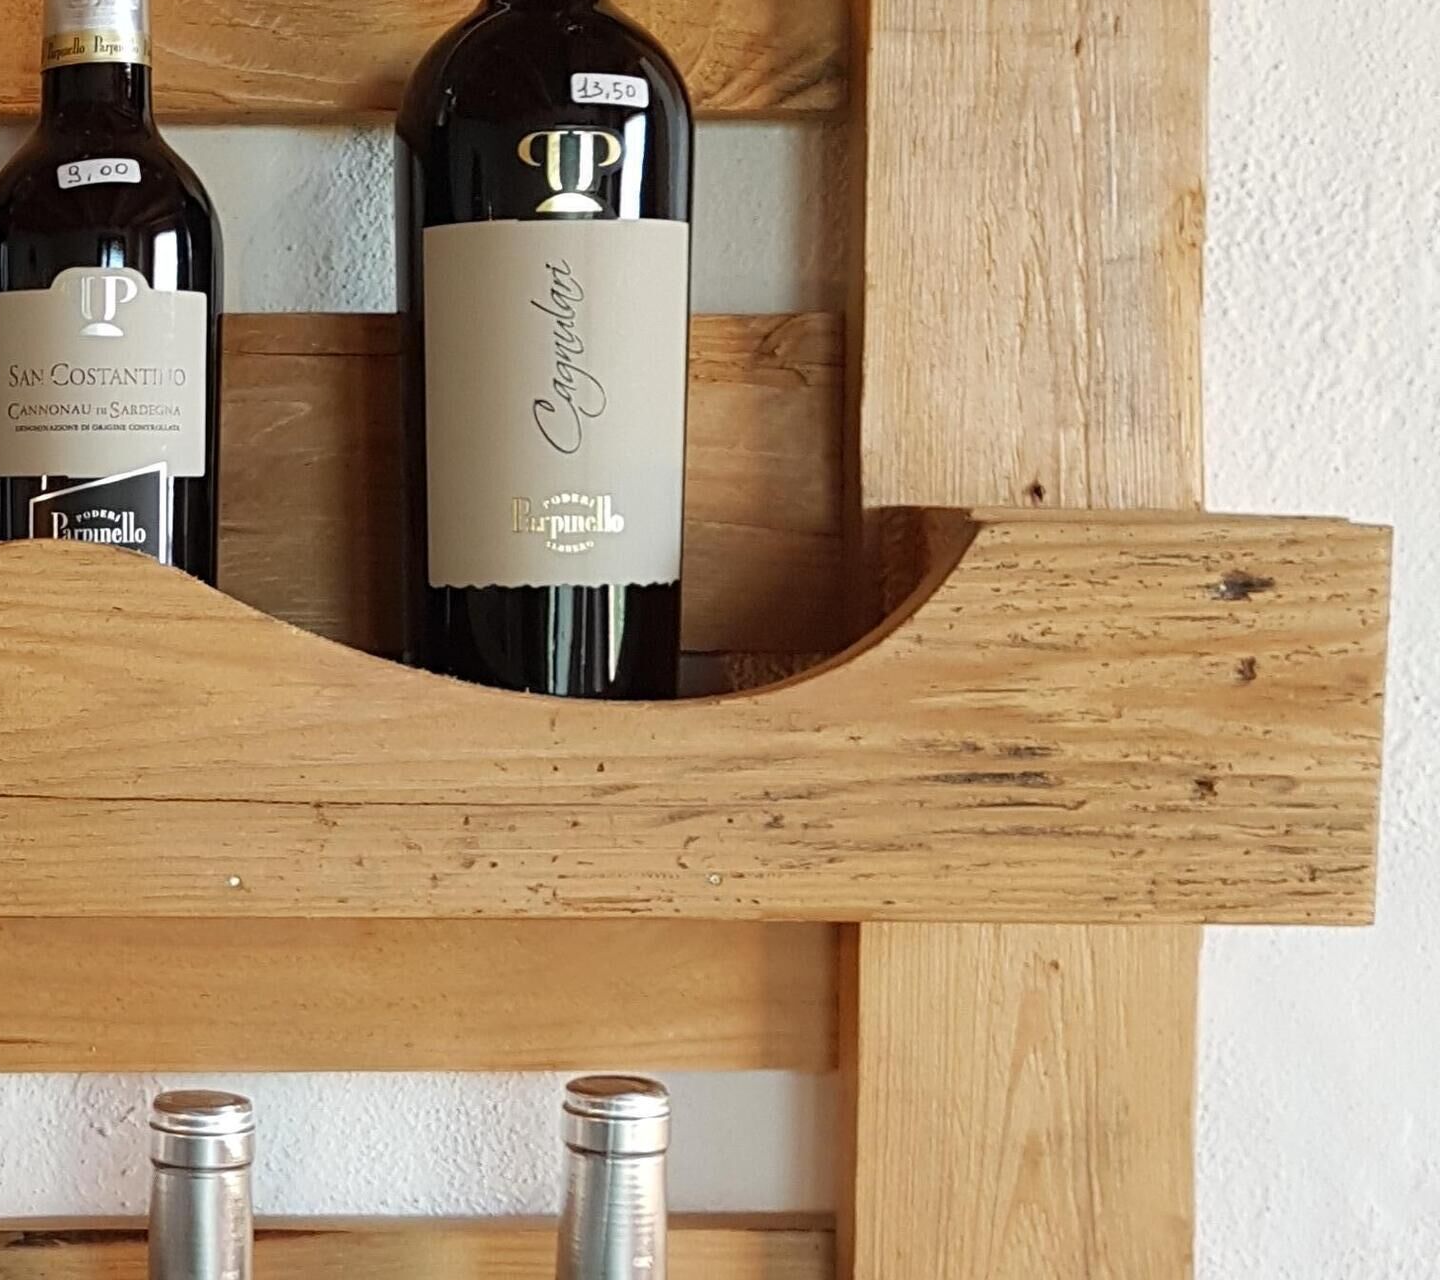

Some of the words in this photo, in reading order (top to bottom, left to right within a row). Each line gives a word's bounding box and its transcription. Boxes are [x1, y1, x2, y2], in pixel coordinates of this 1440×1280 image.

[530, 258, 607, 455] Cagnulari
[8, 364, 45, 388] SAN
[50, 362, 186, 387] COSTANTINO
[7, 402, 92, 420] CANNONAU
[109, 401, 182, 419] SARDEGNA
[75, 509, 121, 523] PODERI
[511, 494, 625, 540] Parpinello
